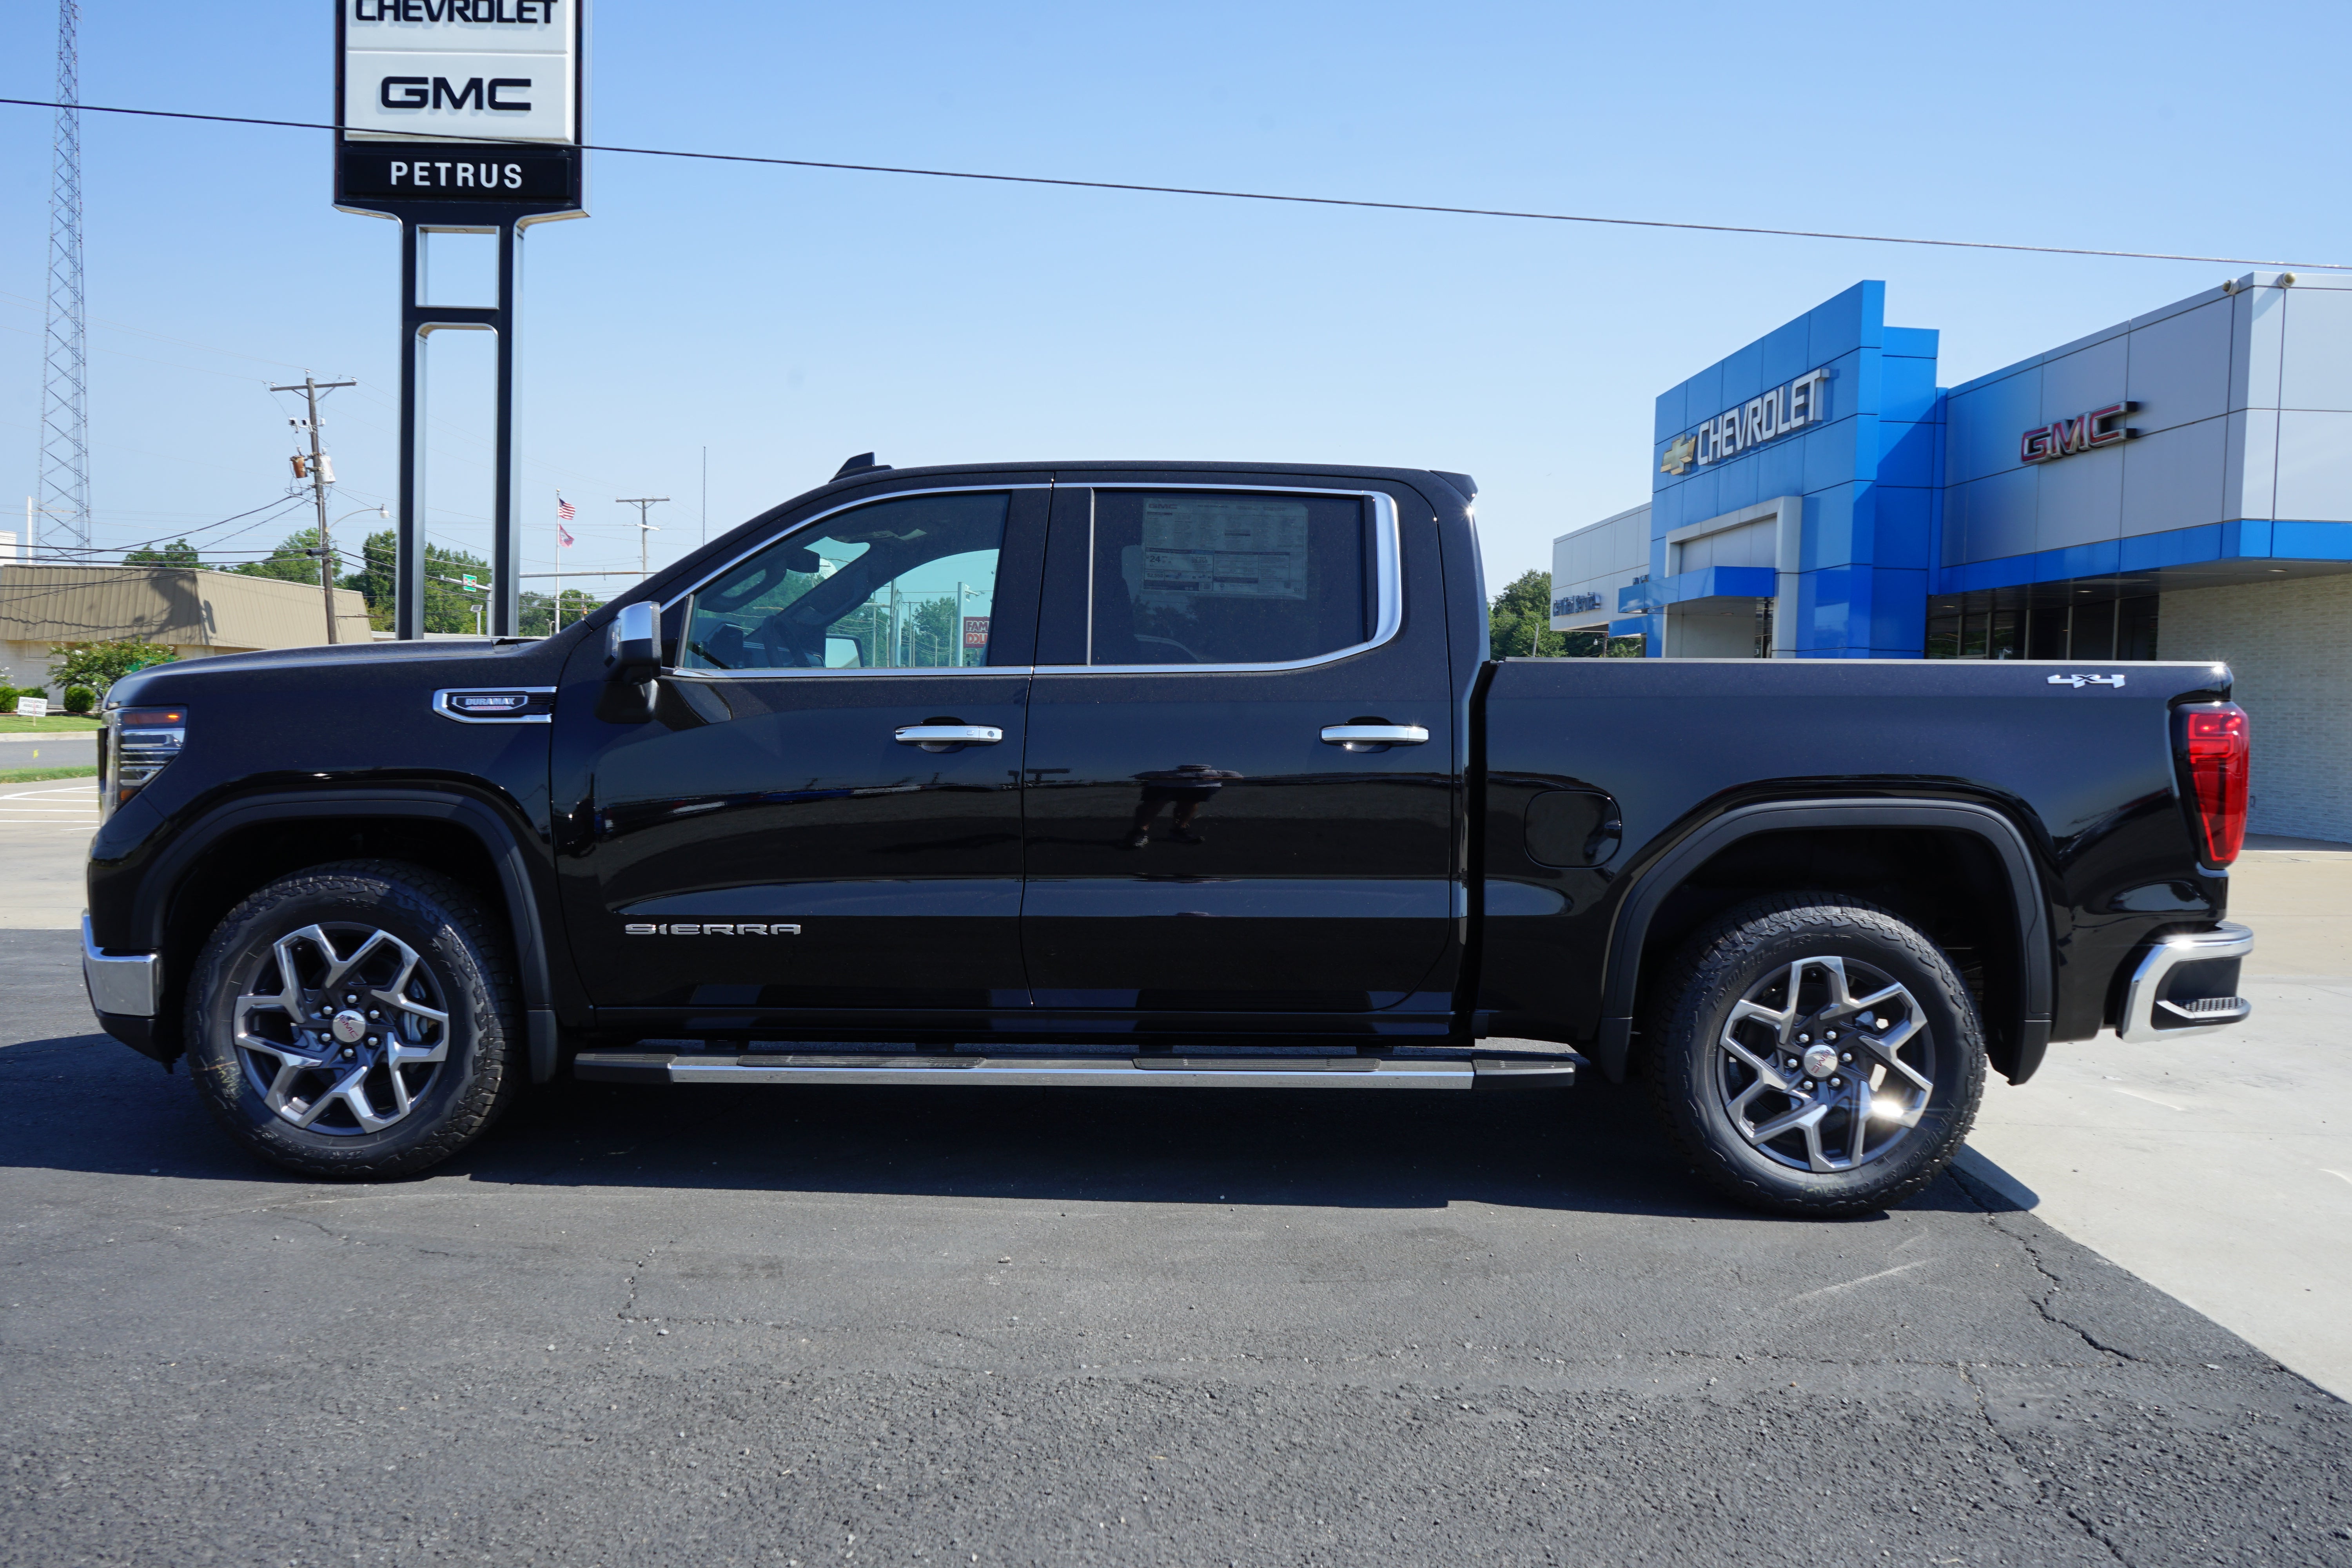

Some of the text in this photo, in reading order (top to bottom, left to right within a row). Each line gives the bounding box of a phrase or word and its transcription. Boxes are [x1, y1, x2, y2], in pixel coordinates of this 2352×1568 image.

[356, 0, 559, 24] CHEVROLET
[381, 76, 531, 111] GMC
[391, 161, 522, 189] PETRUS
[1697, 368, 1829, 466] CHEVROLET
[2021, 400, 2135, 465] GMC
[625, 924, 801, 935] SIERRA
[339, 1014, 358, 1038] GMC
[1811, 1049, 1830, 1073] GMC
